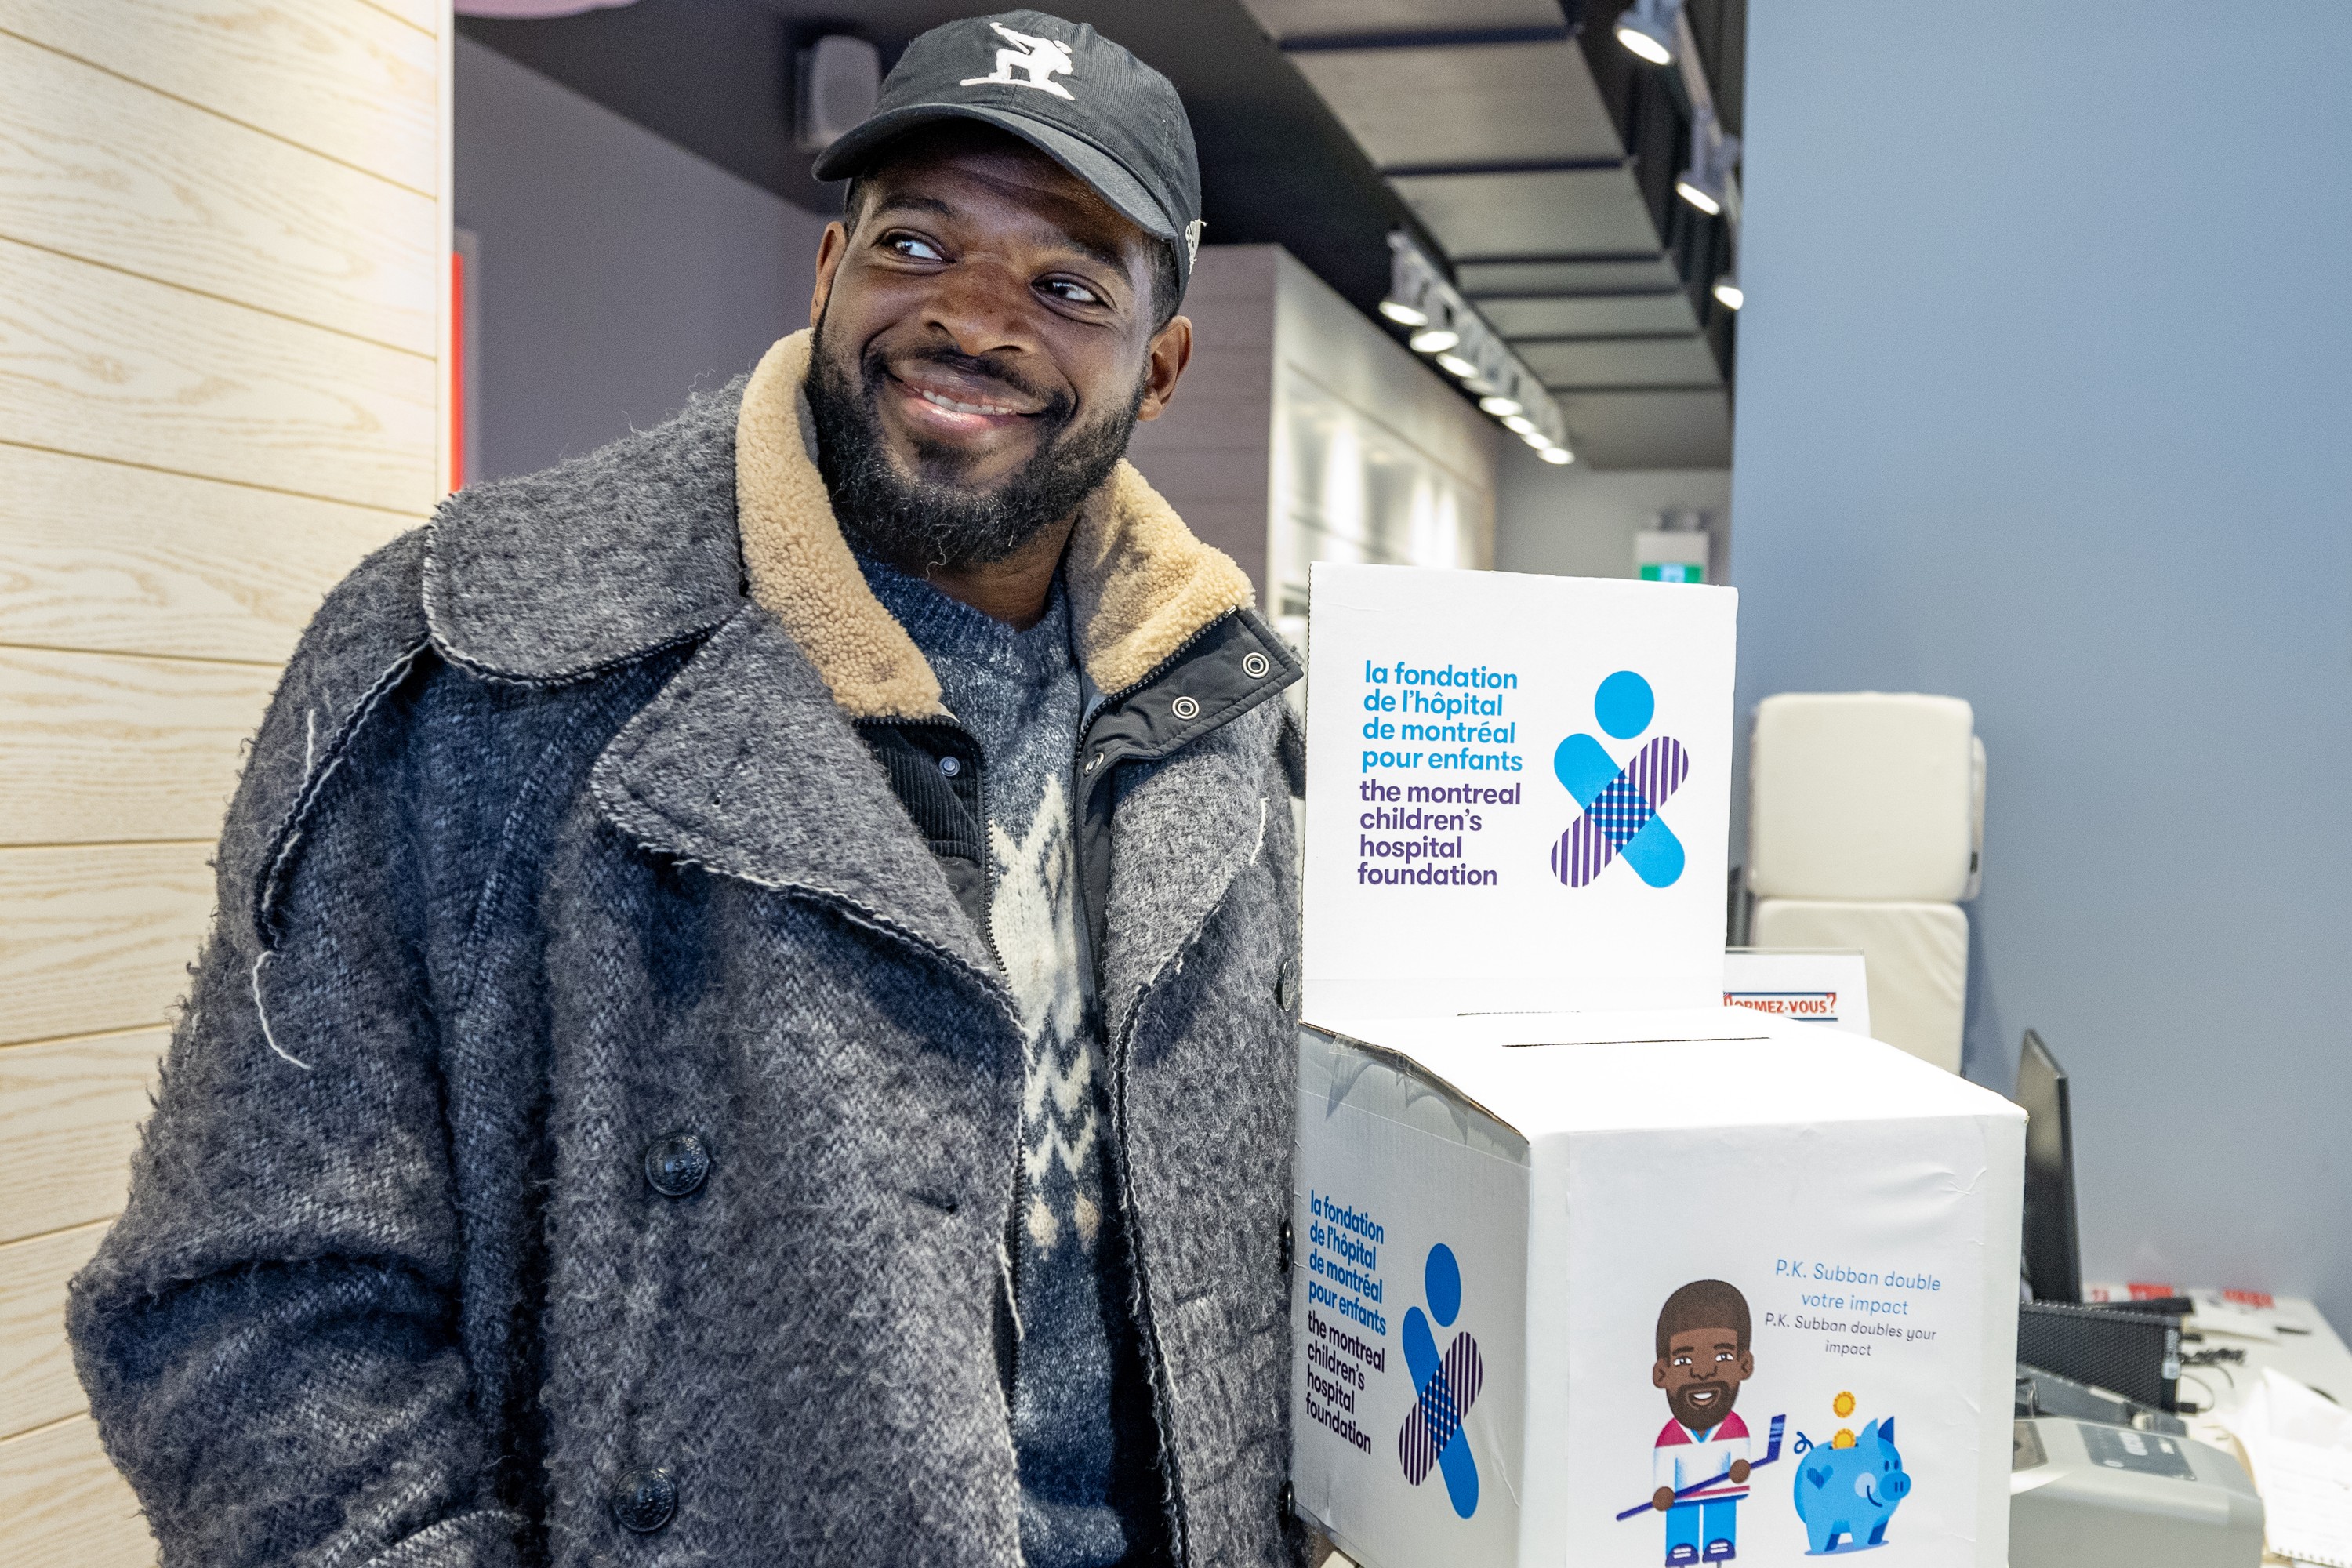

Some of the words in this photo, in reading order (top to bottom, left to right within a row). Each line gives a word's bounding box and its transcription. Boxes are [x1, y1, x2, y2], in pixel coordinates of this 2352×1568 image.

[1365, 659, 1388, 684] la
[1393, 661, 1518, 690] fondation
[1363, 688, 1396, 713] de
[1362, 716, 1396, 741] de
[1401, 720, 1515, 744] montréal
[1362, 748, 1423, 774] pour
[1428, 747, 1523, 772] enfants
[1359, 778, 1402, 803] the
[1407, 782, 1521, 806] montreal
[1359, 833, 1462, 865] hospital
[1357, 861, 1498, 887] foundation
[1310, 1189, 1322, 1218] la
[1323, 1195, 1385, 1245] fondation
[1309, 1219, 1326, 1247] de
[1308, 1247, 1326, 1275] de
[1326, 1260, 1383, 1305] montréal
[1775, 1258, 1807, 1279] P.K.
[1813, 1262, 1879, 1286] Subban
[1884, 1270, 1942, 1292] double
[1308, 1279, 1338, 1309] pour
[1338, 1296, 1387, 1337] enfants
[1802, 1293, 1845, 1310] votre
[1849, 1294, 1909, 1316] impact
[1307, 1309, 1327, 1340] the
[1328, 1325, 1385, 1374] montreal
[1765, 1312, 1791, 1329] P.K.
[1795, 1315, 1847, 1334] Subban
[1850, 1320, 1904, 1338] doubles
[1906, 1329, 1937, 1342] your
[1824, 1339, 1872, 1358] impact
[1306, 1363, 1356, 1415] hospital
[1305, 1391, 1372, 1456] foundation
